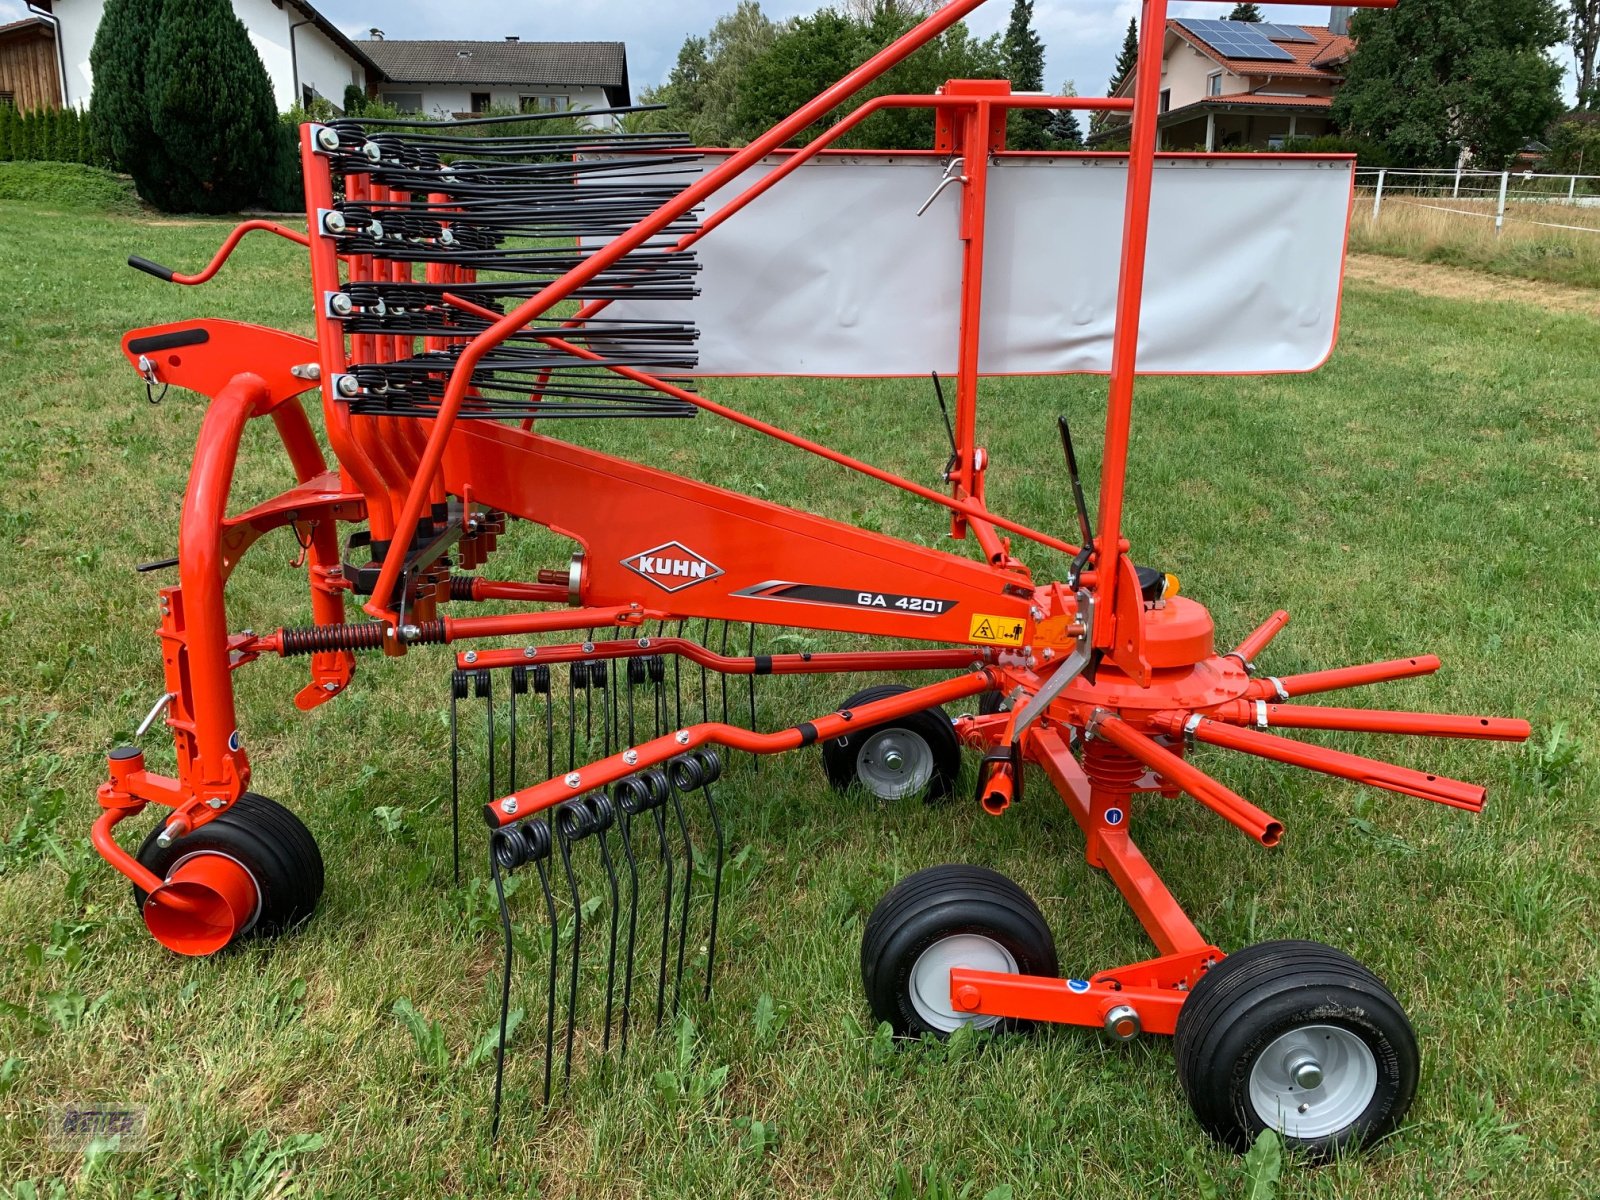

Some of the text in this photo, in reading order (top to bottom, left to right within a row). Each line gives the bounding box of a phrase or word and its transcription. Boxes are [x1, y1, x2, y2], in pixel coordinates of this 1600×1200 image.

[638, 556, 707, 578] KUHN
[857, 592, 943, 613] GA 4201
